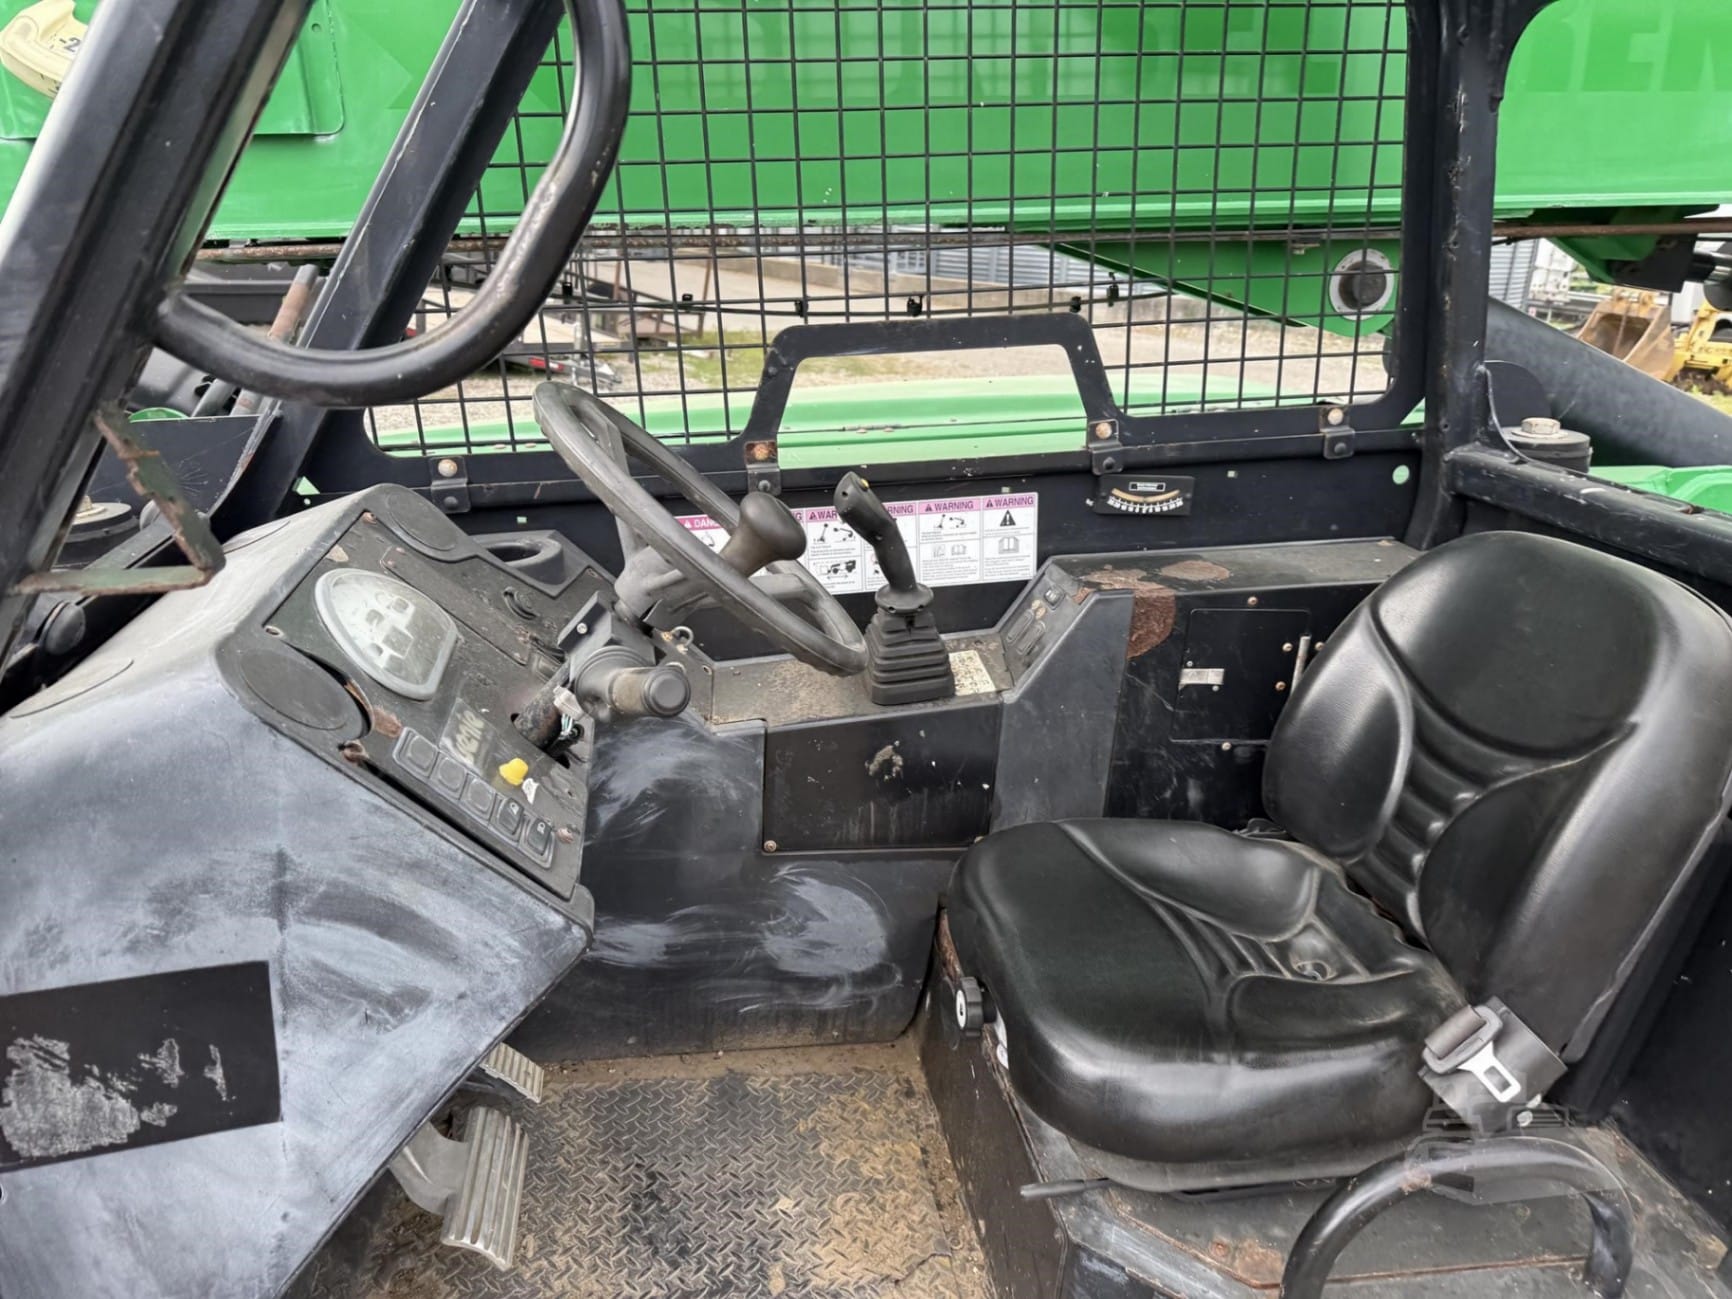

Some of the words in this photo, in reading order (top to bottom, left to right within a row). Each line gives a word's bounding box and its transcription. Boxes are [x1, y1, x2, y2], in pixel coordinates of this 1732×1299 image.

[934, 500, 974, 511] WARNING
[994, 495, 1034, 507] WARNING
[887, 504, 914, 515] RNING
